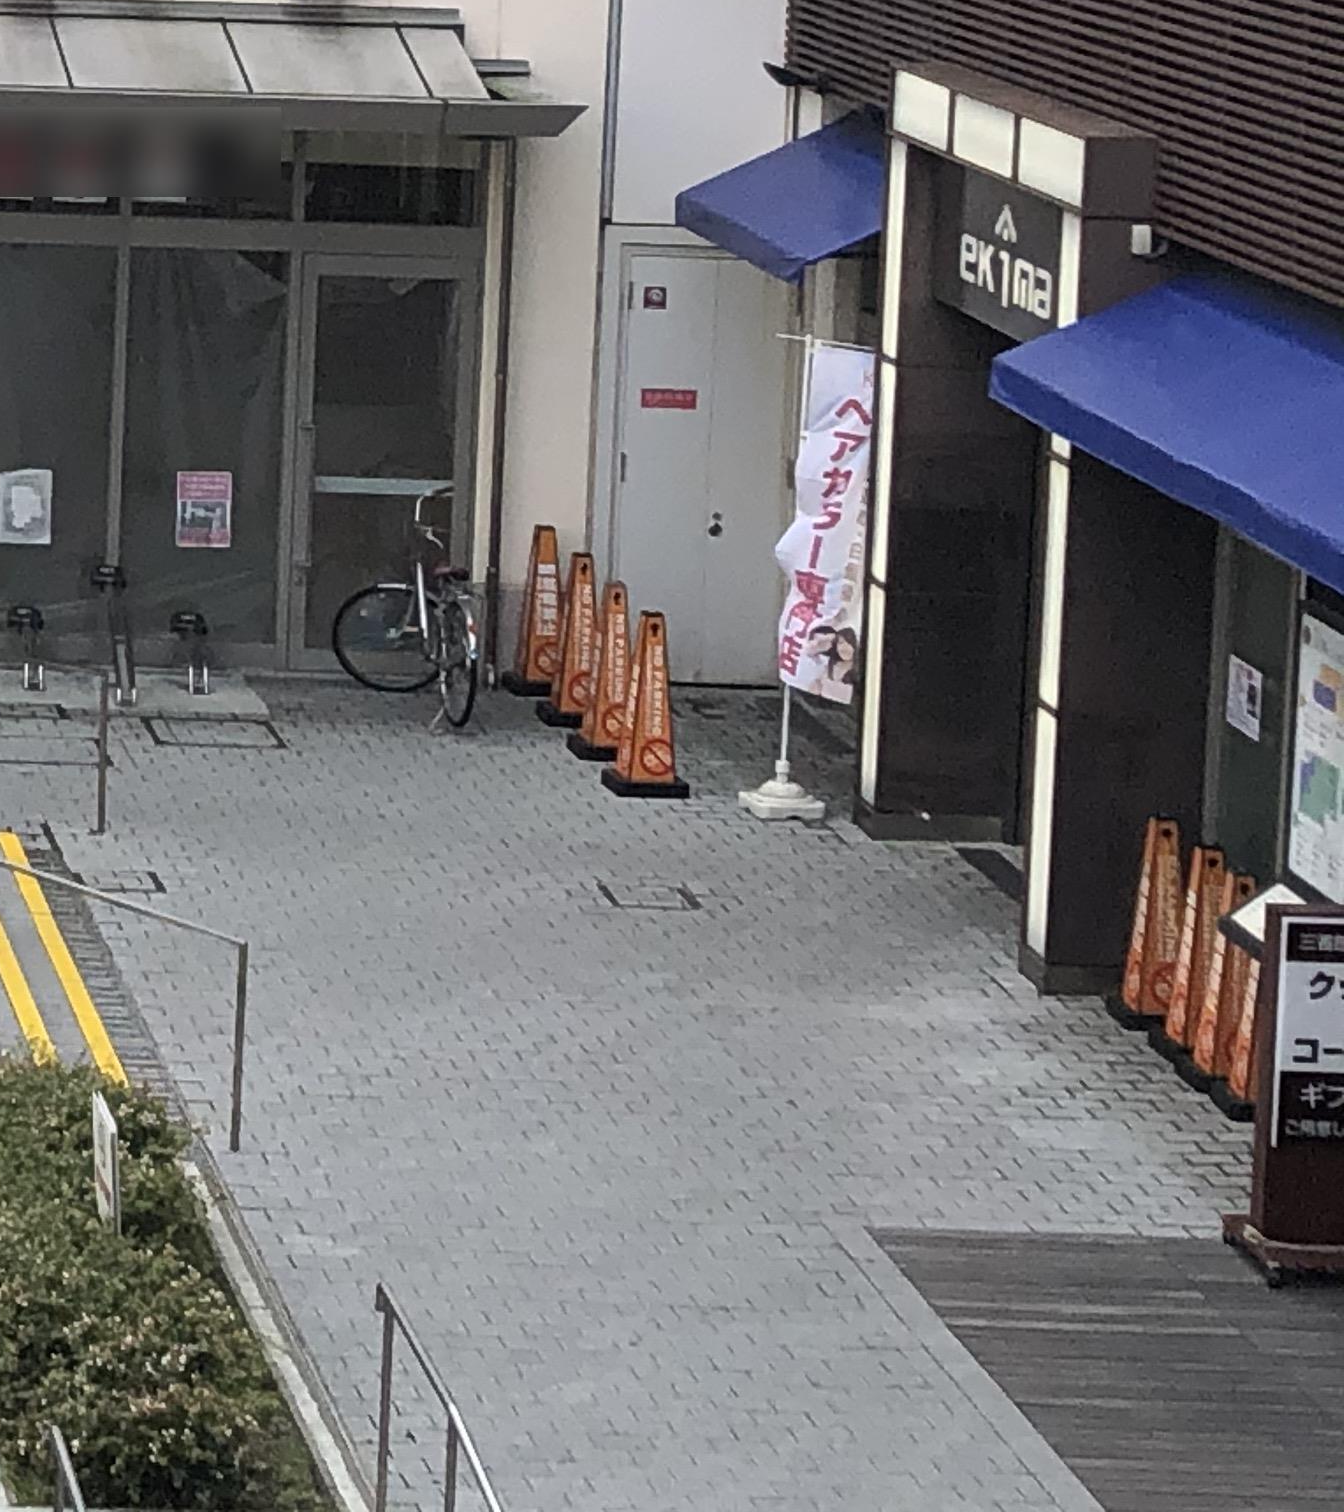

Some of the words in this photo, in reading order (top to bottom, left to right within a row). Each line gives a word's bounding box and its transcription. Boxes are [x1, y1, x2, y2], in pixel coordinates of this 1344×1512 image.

[652, 644, 664, 666] NO
[651, 670, 665, 738] PARKING
[1309, 970, 1344, 1000] ク
